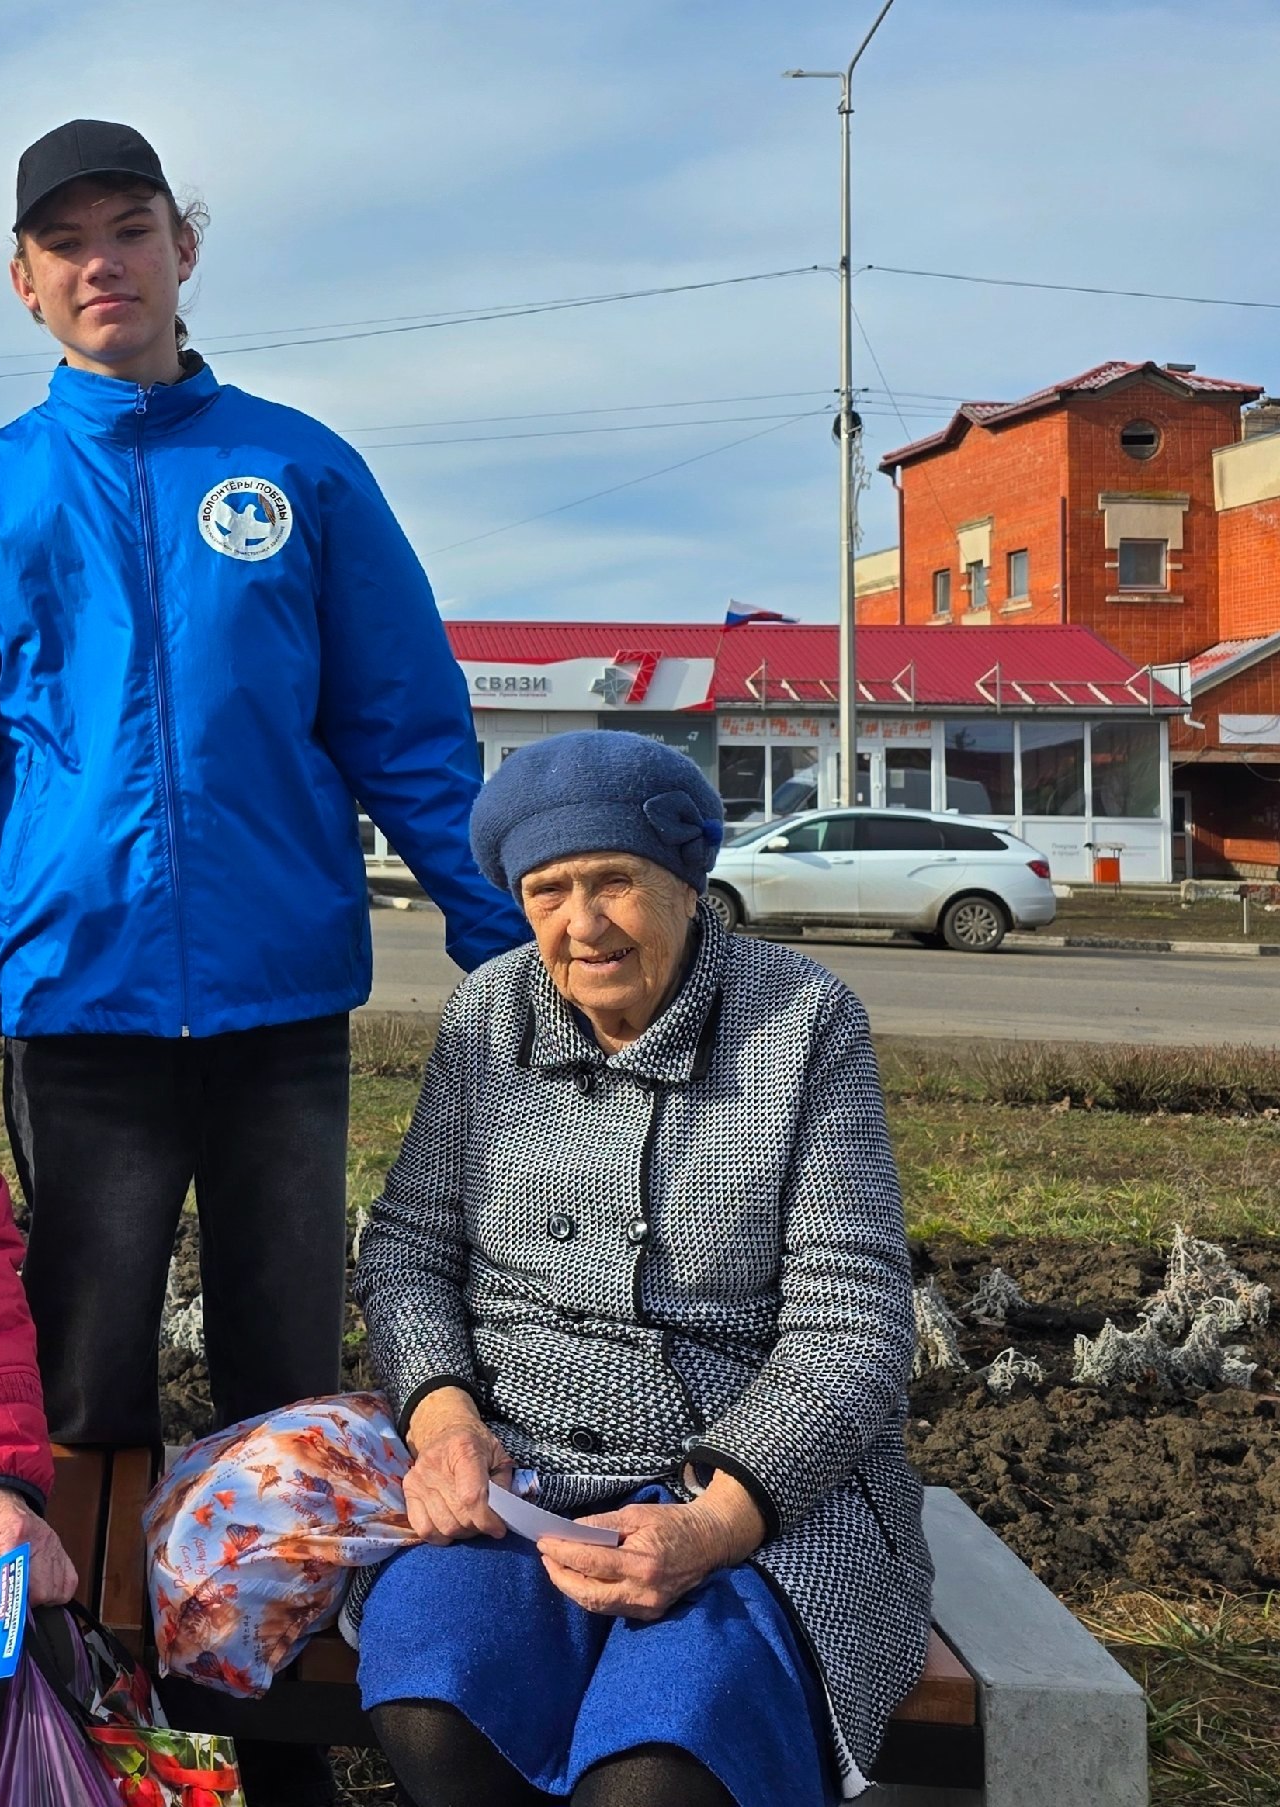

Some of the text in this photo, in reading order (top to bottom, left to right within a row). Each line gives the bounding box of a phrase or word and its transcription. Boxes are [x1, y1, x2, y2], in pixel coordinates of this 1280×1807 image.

[203, 481, 288, 521] ВОЛОНТЁРЫ ПОБЕДЫ
[475, 676, 547, 691] СВЯЗИ
